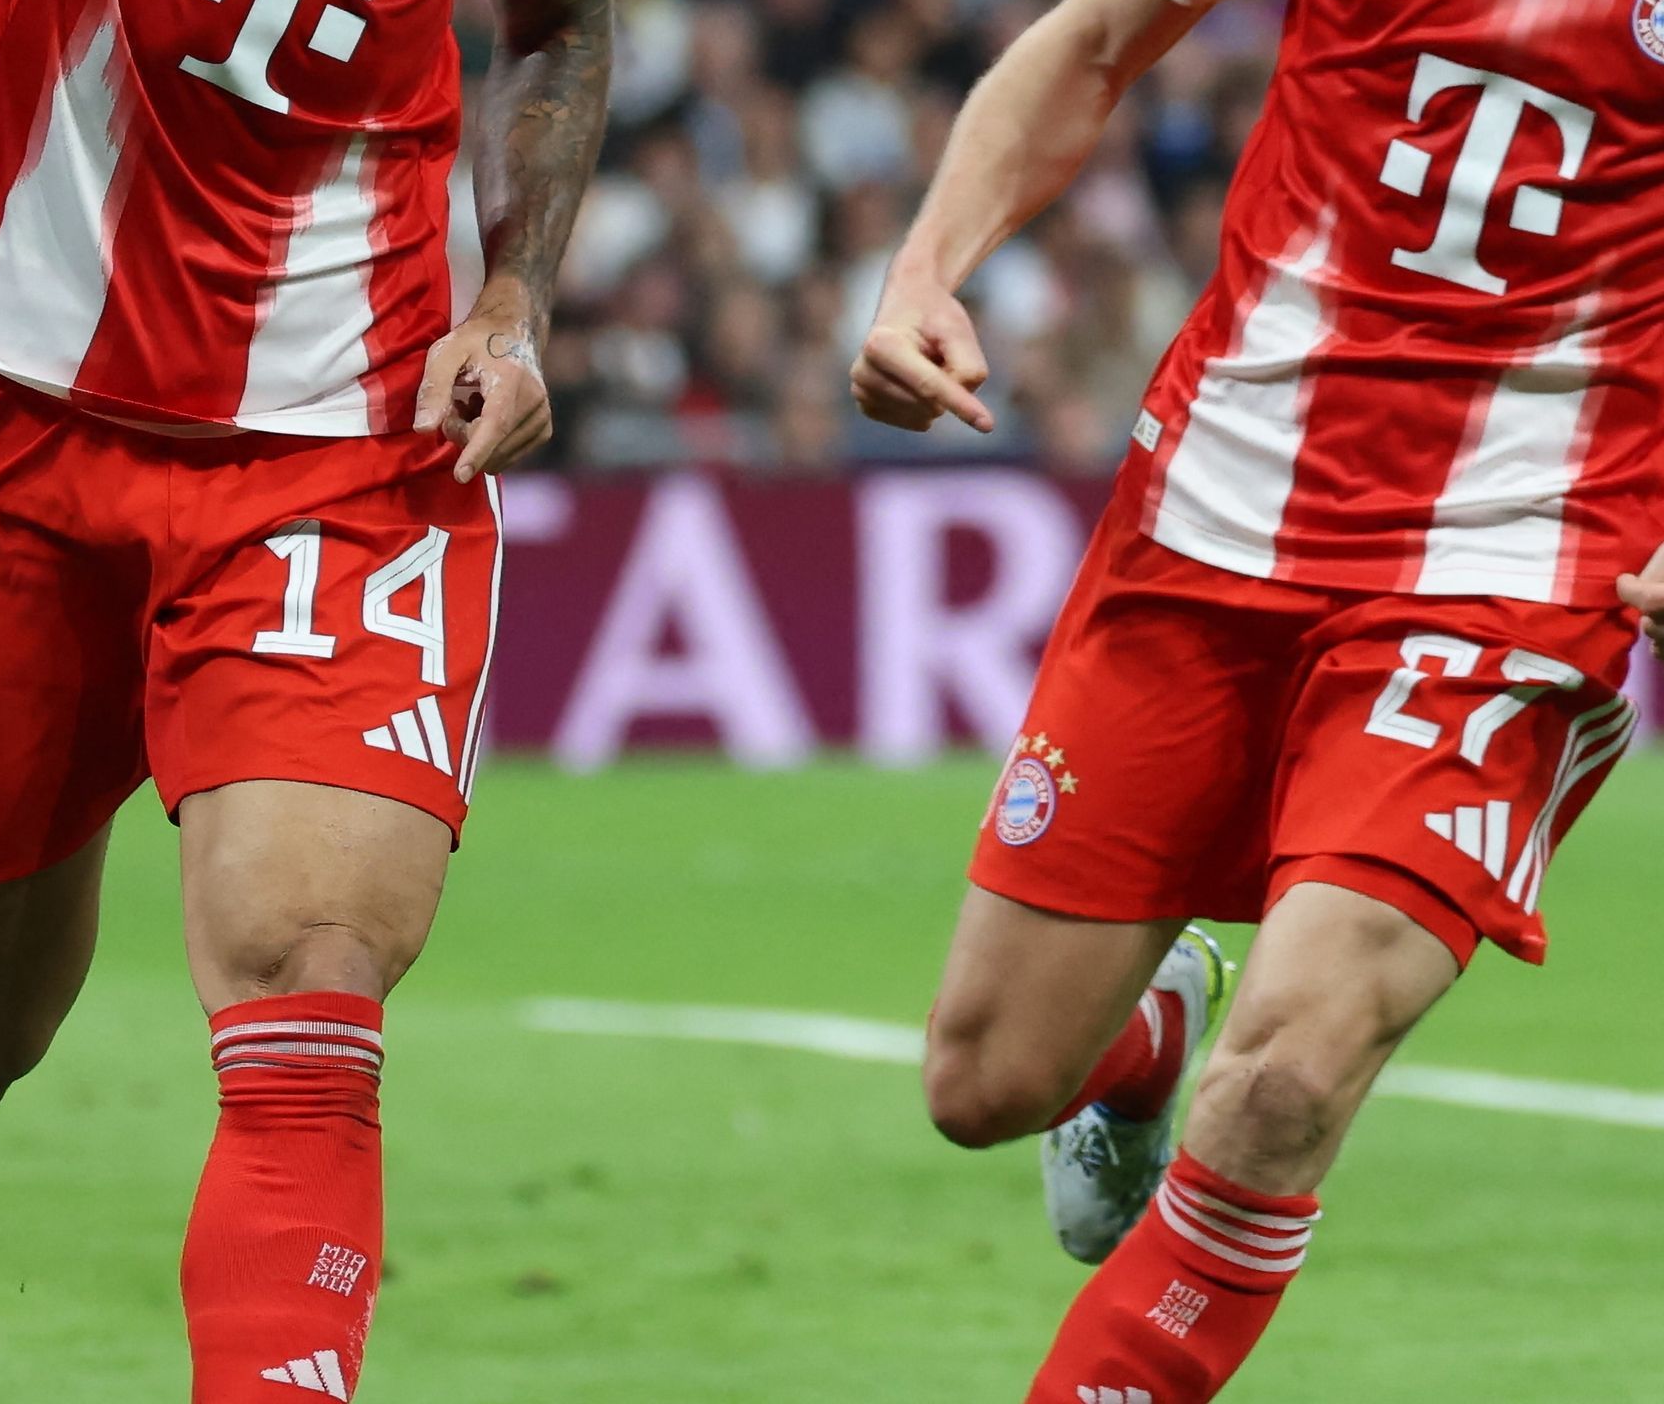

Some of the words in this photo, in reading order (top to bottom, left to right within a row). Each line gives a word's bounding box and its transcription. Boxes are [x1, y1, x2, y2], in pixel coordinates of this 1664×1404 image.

[1380, 52, 1596, 296] T
[251, 518, 451, 687] 14
[1363, 632, 1585, 767] 27
[313, 1257, 360, 1283] SAN
[318, 1242, 367, 1271] MIA
[306, 1269, 353, 1297] MIA
[1166, 1279, 1209, 1312] MIA
[1144, 1306, 1190, 1339] MIA
[1157, 1294, 1201, 1326] SAN
